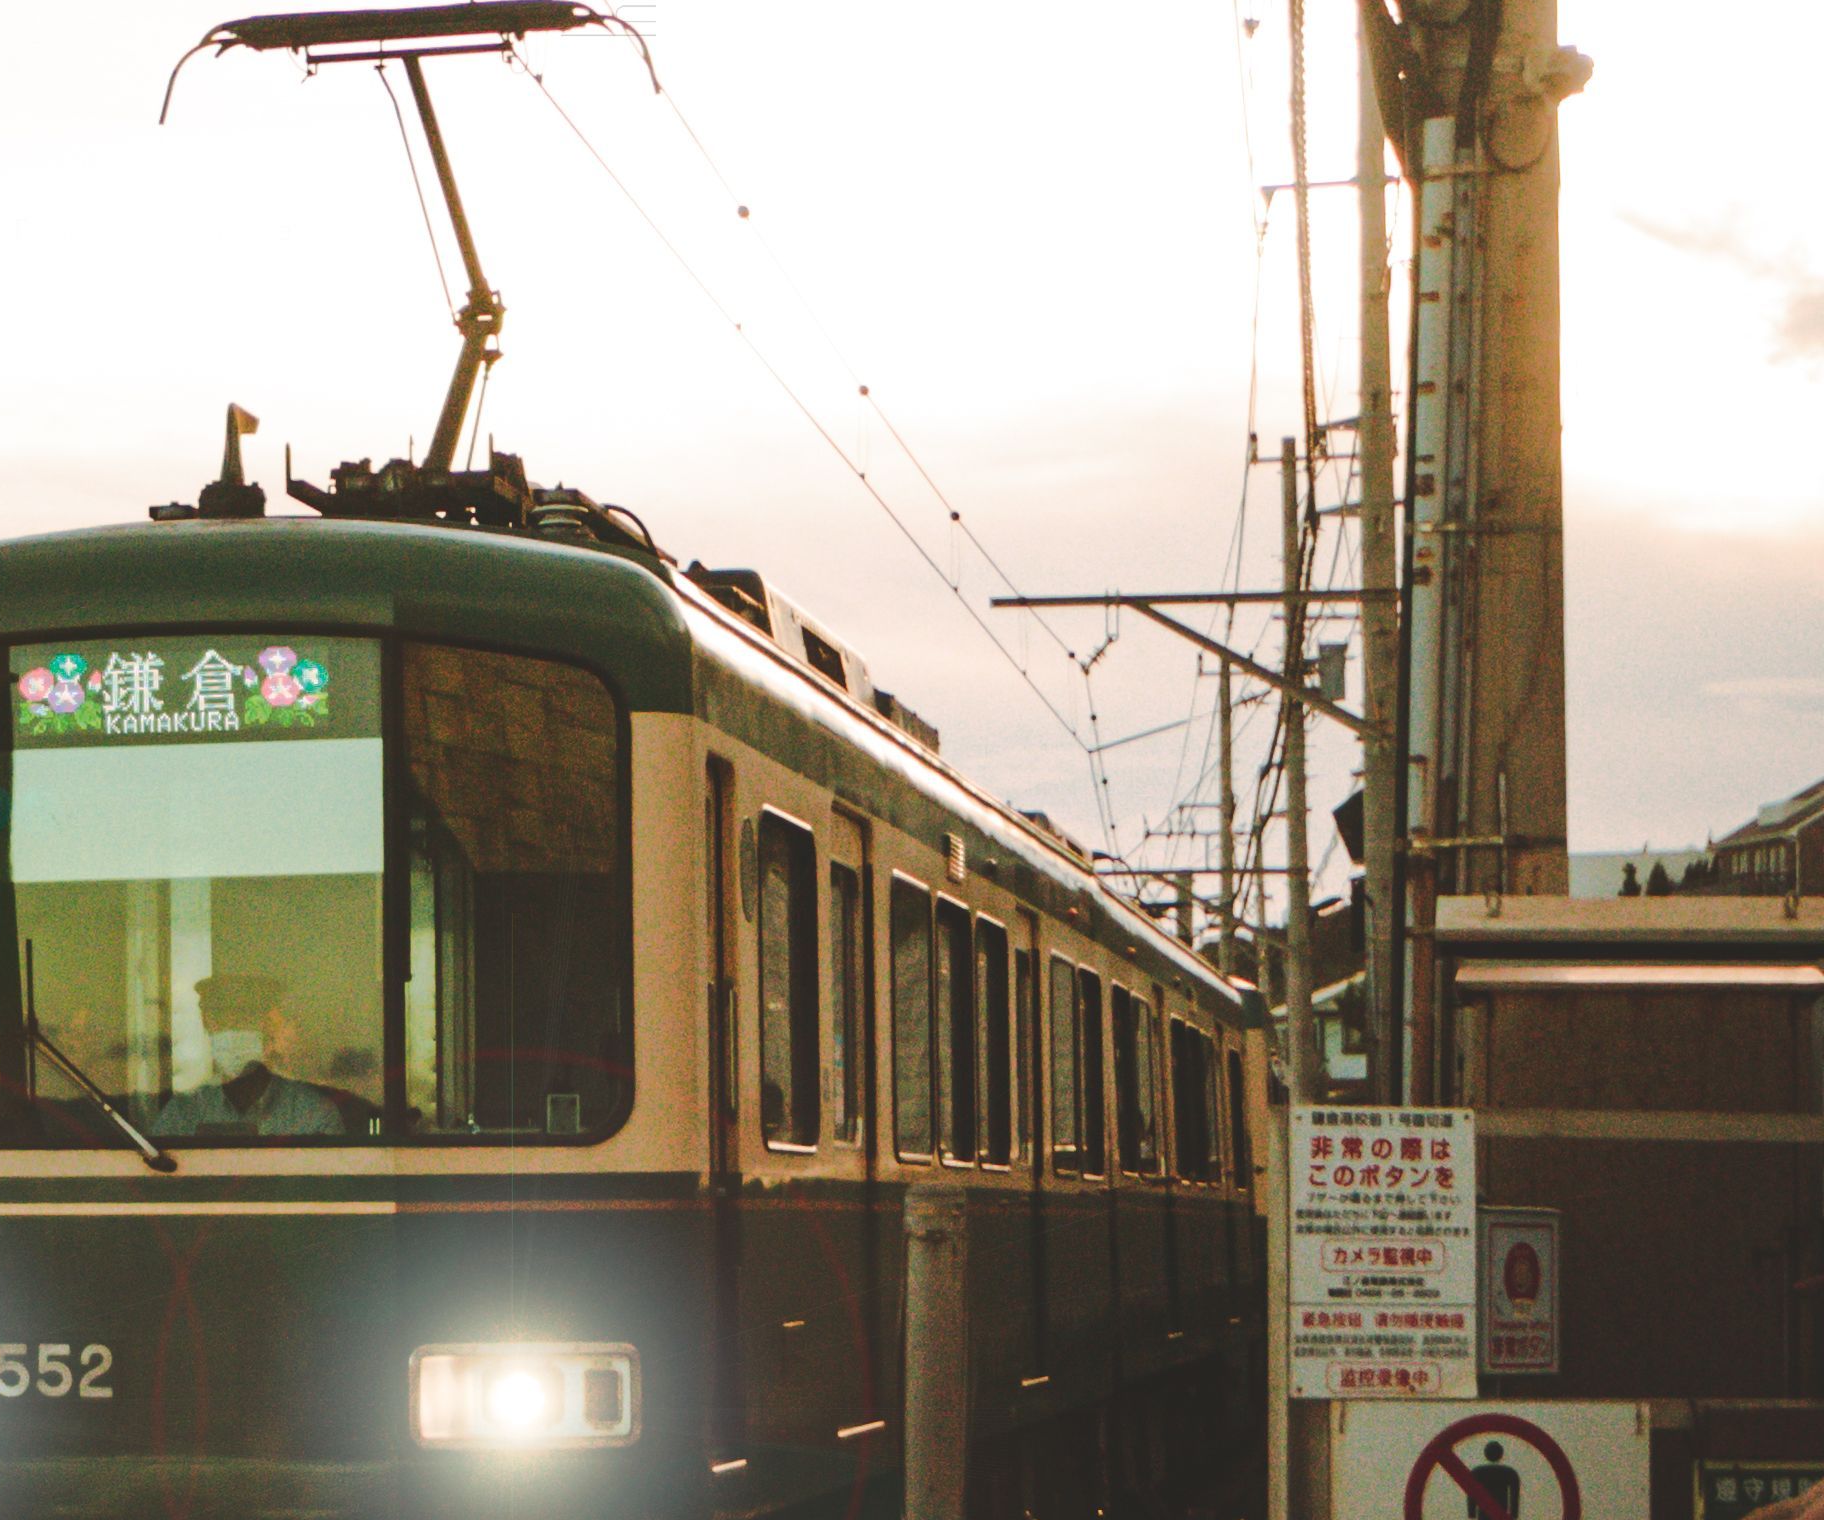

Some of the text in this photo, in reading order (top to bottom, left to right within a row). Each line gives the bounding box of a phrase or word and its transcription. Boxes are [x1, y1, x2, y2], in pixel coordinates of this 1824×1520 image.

[102, 649, 244, 712] 鎌倉
[104, 711, 241, 734] KAMAKURA
[1310, 1136, 1451, 1160] 非常の際は
[1307, 1164, 1455, 1189] このボタンを
[1333, 1247, 1433, 1266] カメラ監視中
